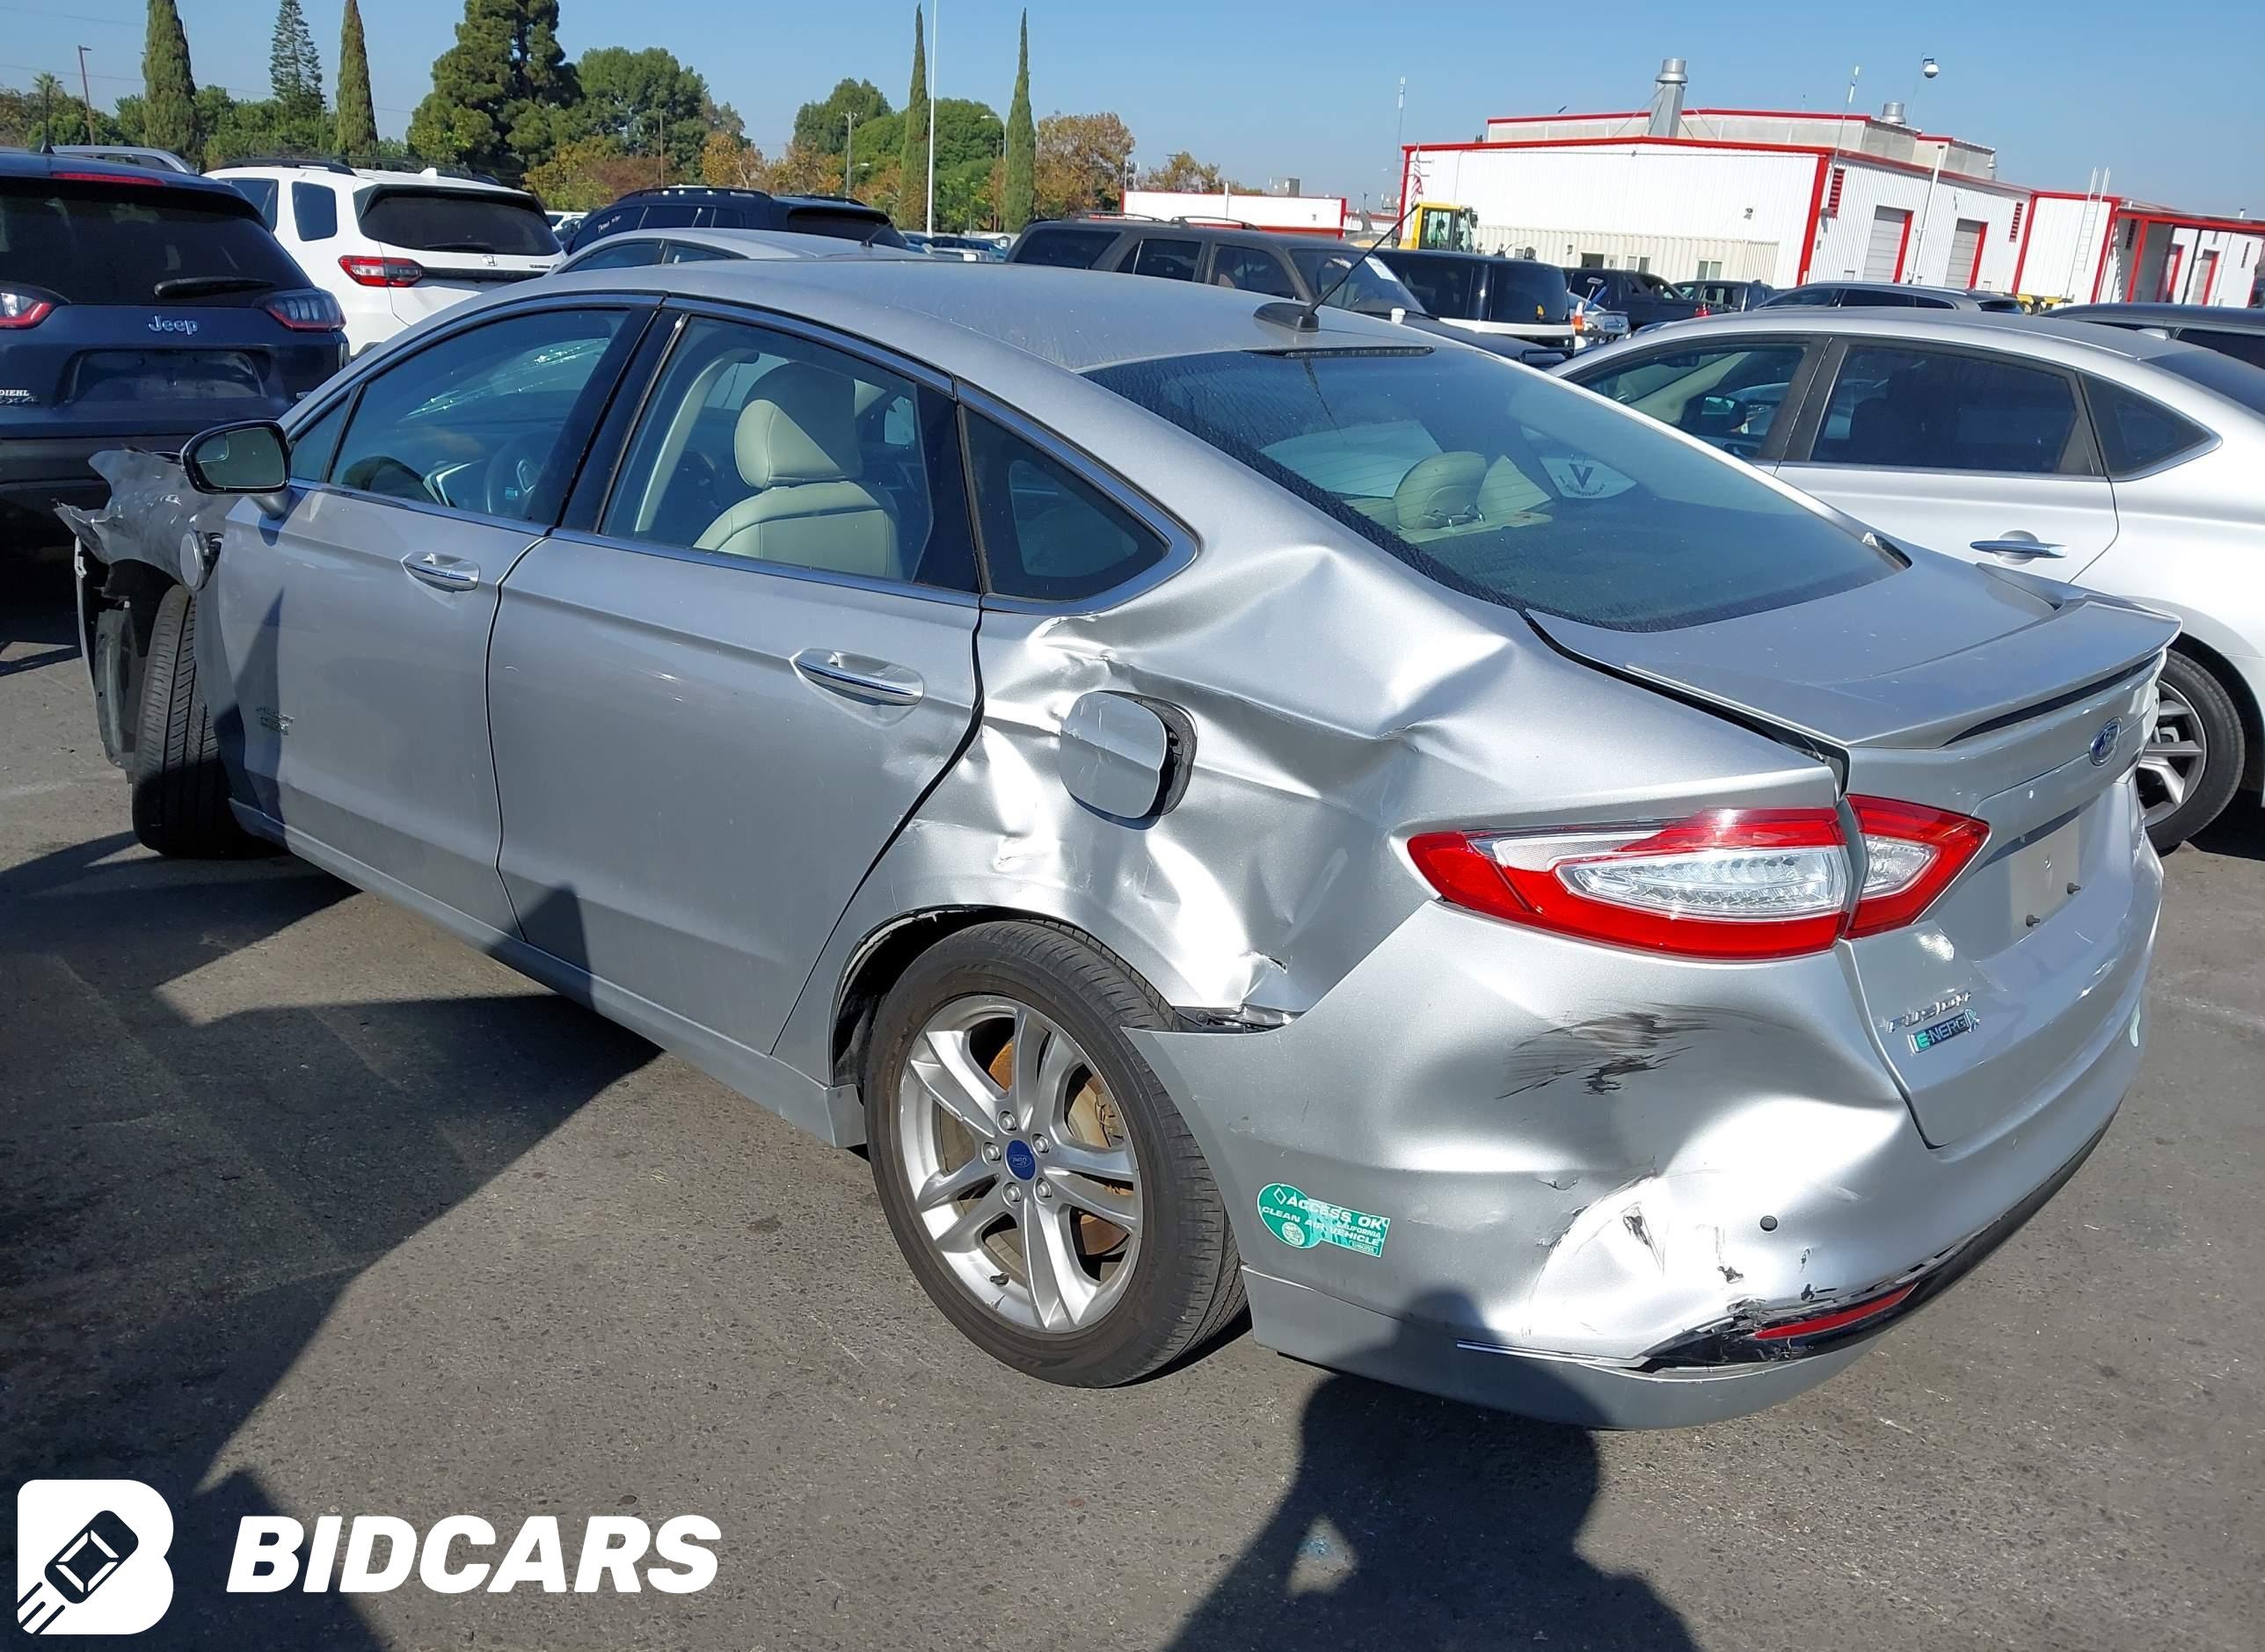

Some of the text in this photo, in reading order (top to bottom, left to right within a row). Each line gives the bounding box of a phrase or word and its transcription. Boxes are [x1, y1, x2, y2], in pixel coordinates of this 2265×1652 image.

[148, 315, 198, 336] Jeep
[1262, 1206, 1301, 1223] CLEAN
[1330, 1226, 1380, 1247] VEHICLE
[1358, 1216, 1382, 1231] OK
